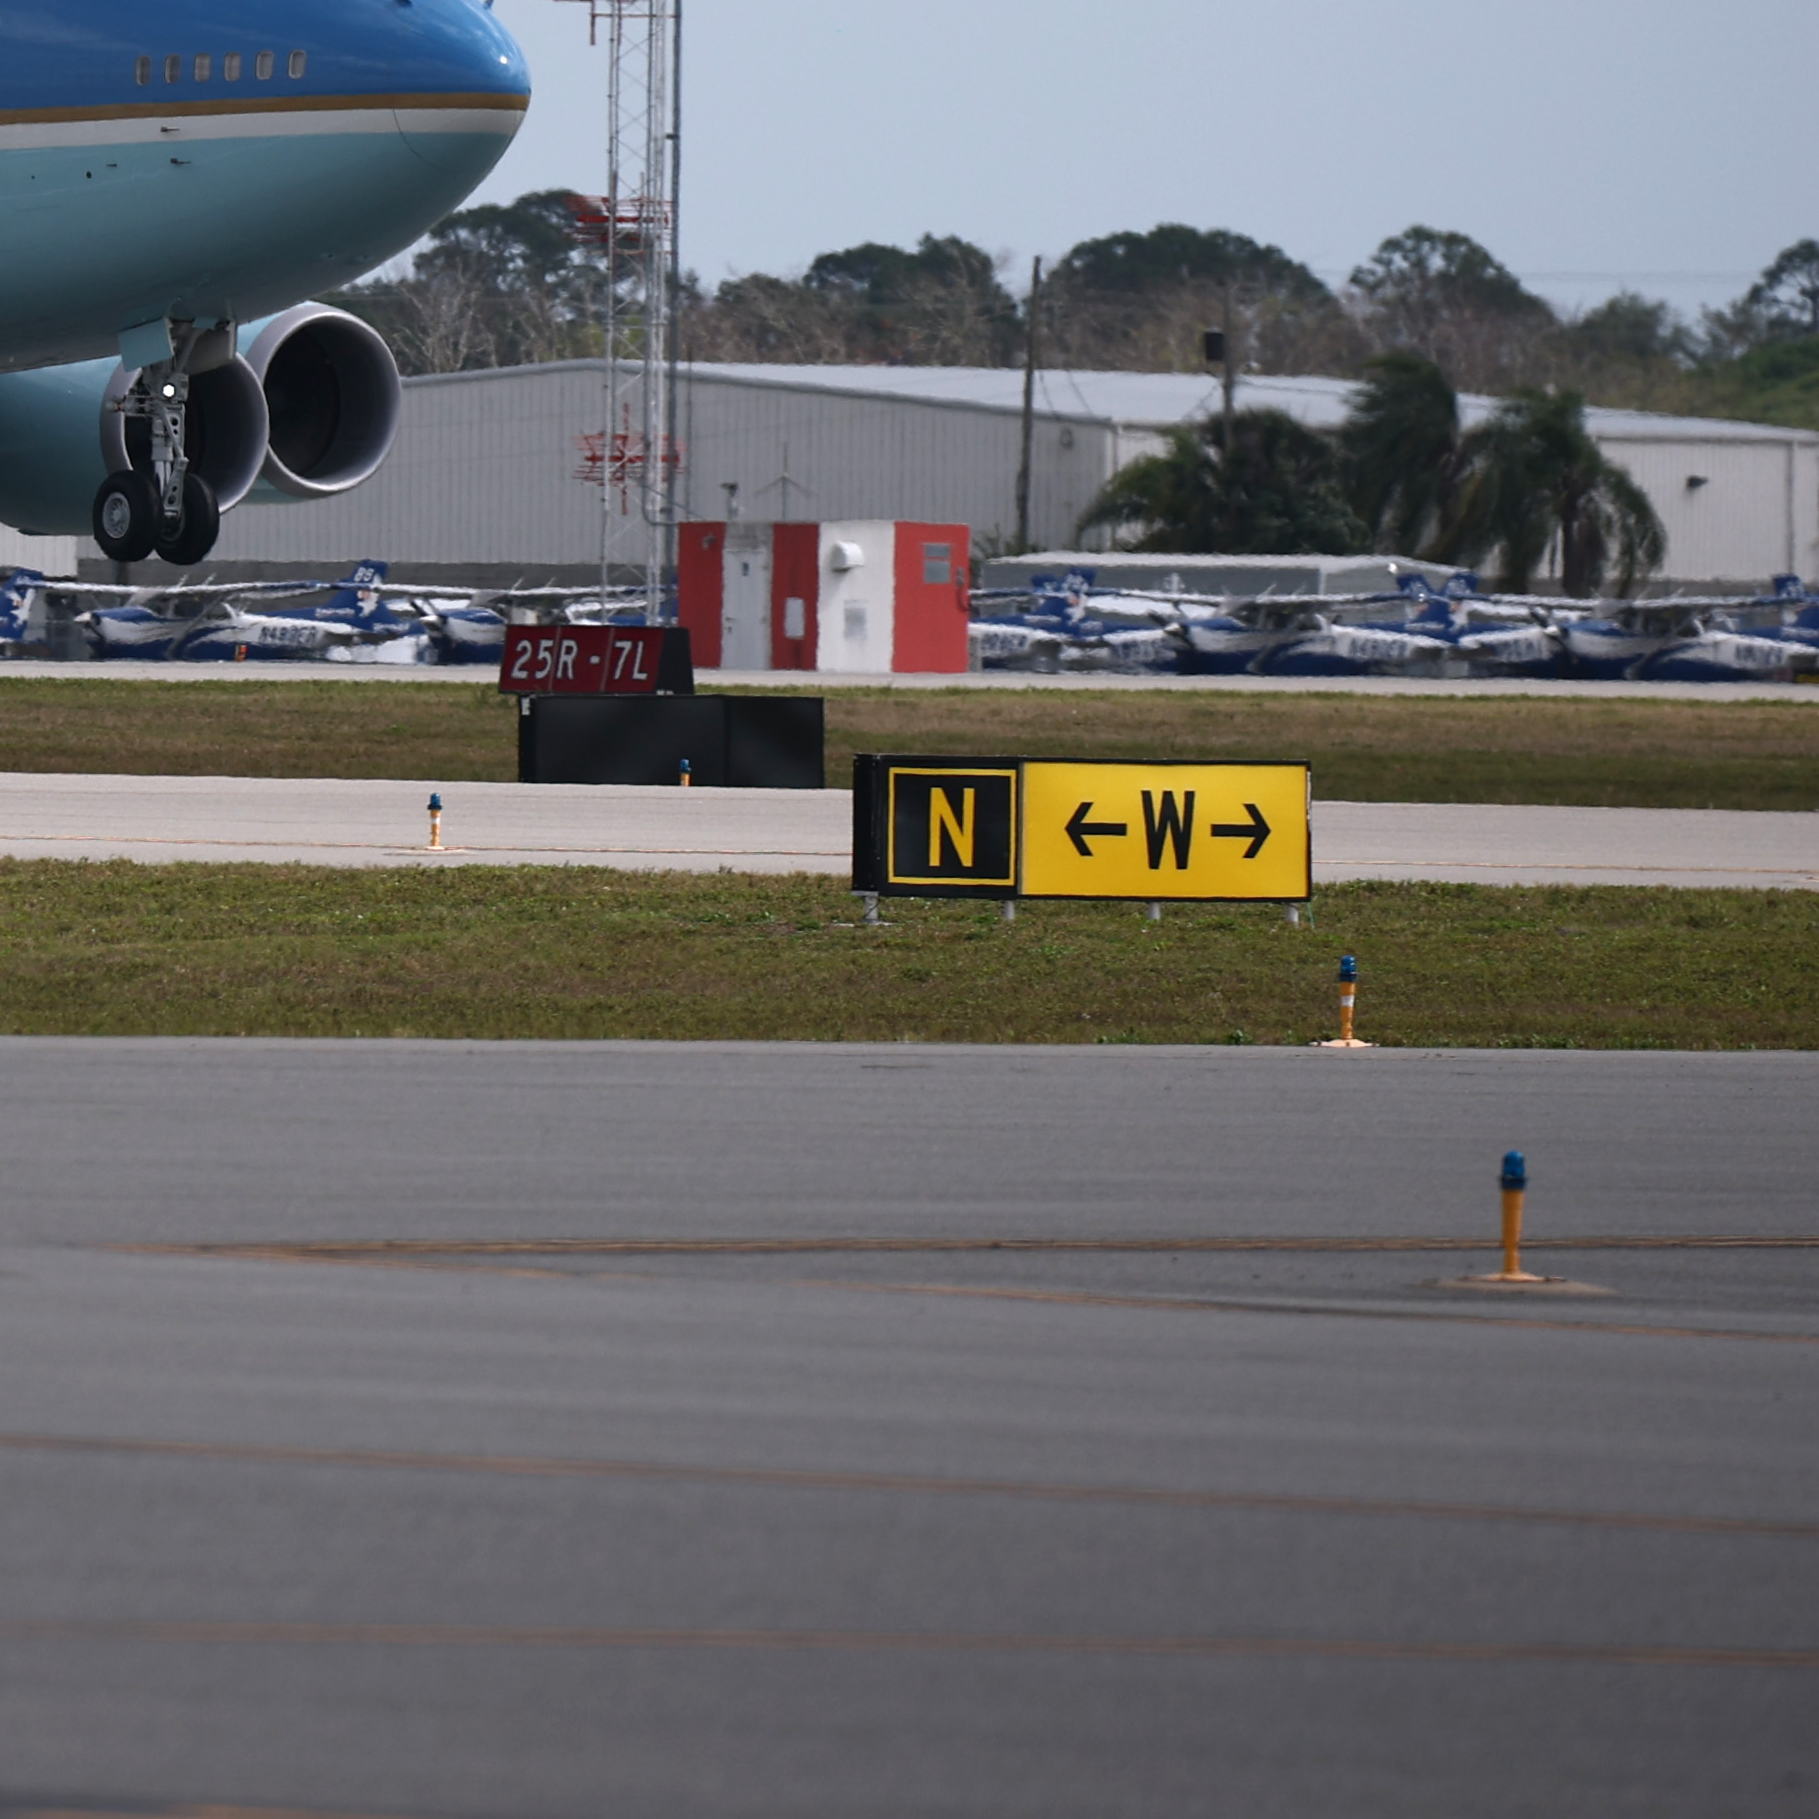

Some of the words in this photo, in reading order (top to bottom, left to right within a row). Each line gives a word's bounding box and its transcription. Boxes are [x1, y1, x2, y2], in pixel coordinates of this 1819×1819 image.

[511, 639, 578, 679] 25R
[614, 641, 648, 680] 7L
[929, 787, 975, 867] N
[1141, 790, 1196, 870] W
